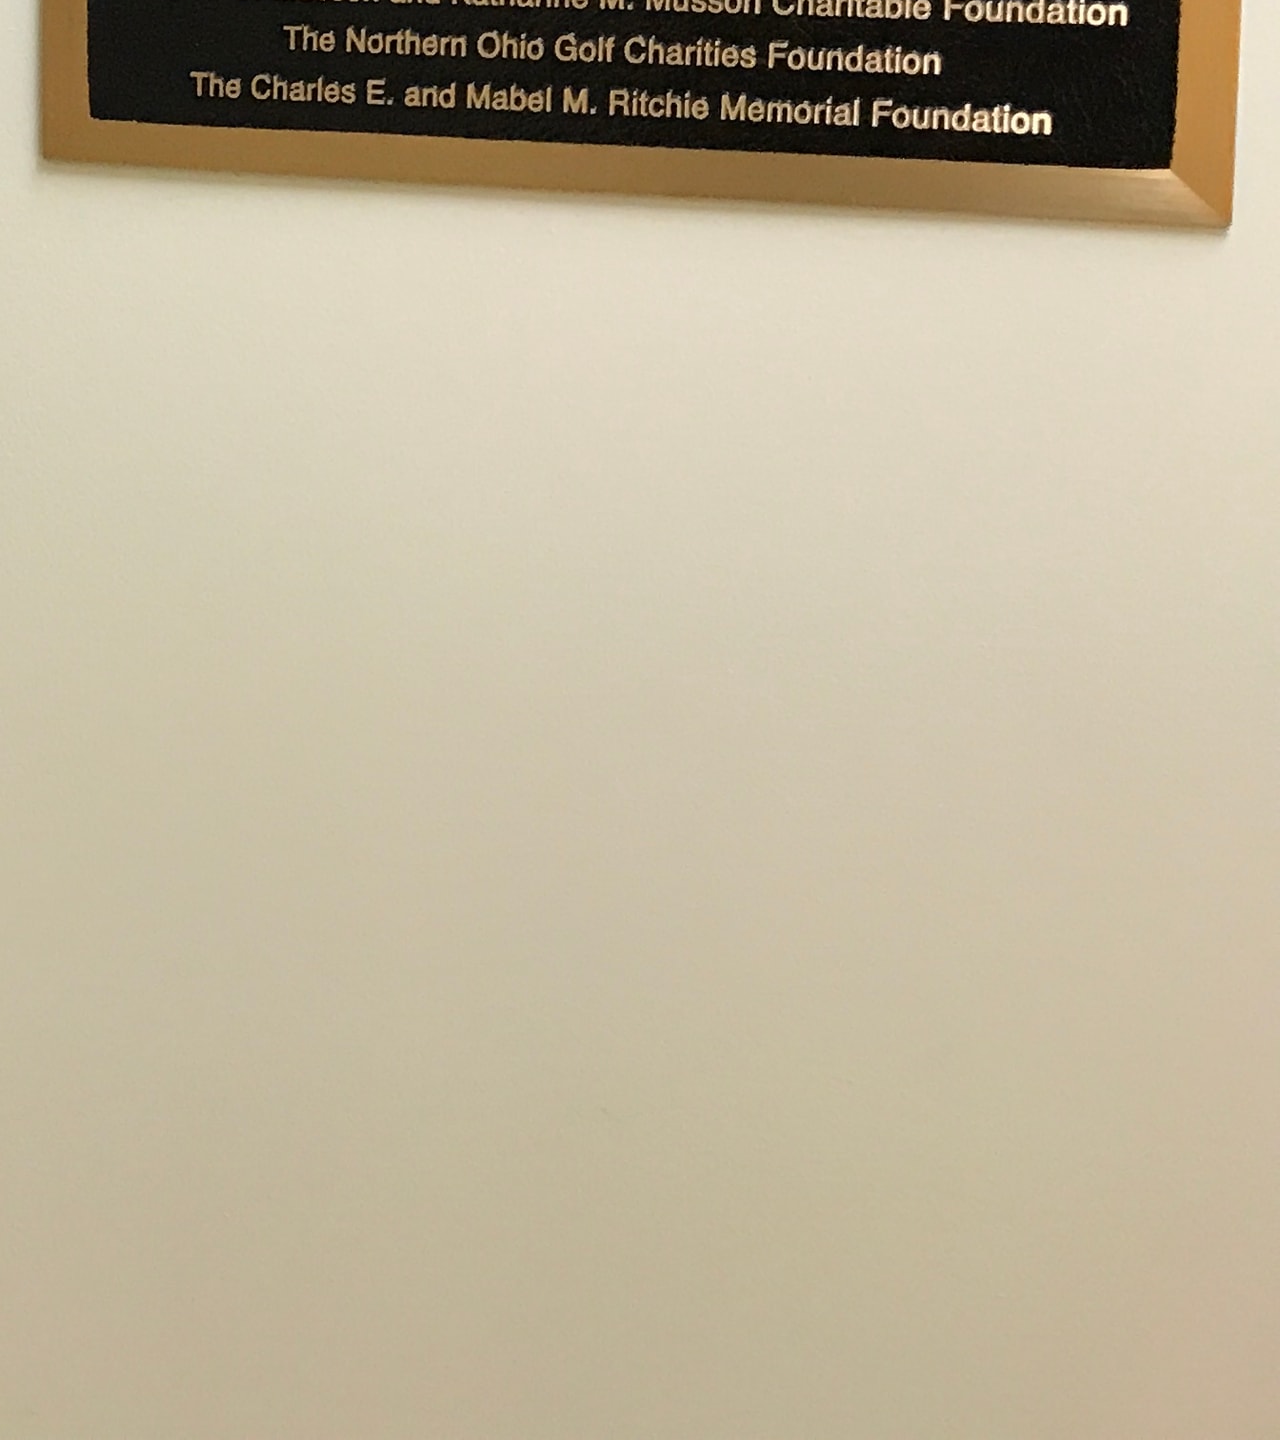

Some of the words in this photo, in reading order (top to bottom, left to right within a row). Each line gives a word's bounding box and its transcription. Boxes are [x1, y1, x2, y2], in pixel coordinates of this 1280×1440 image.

[283, 25, 335, 53] The
[346, 27, 467, 58] Northern
[477, 30, 542, 61] Ohio
[554, 32, 614, 64] Golf
[624, 35, 756, 69] Charities
[767, 40, 941, 75] Foundation
[190, 71, 241, 99] The
[250, 74, 356, 105] Charles
[366, 78, 394, 106] E.
[403, 81, 456, 109] and
[466, 82, 551, 113] Mabel
[562, 86, 597, 115] M.
[609, 89, 709, 120] Ritchie
[720, 92, 860, 127] Memorial
[871, 100, 1052, 136] Foundation
